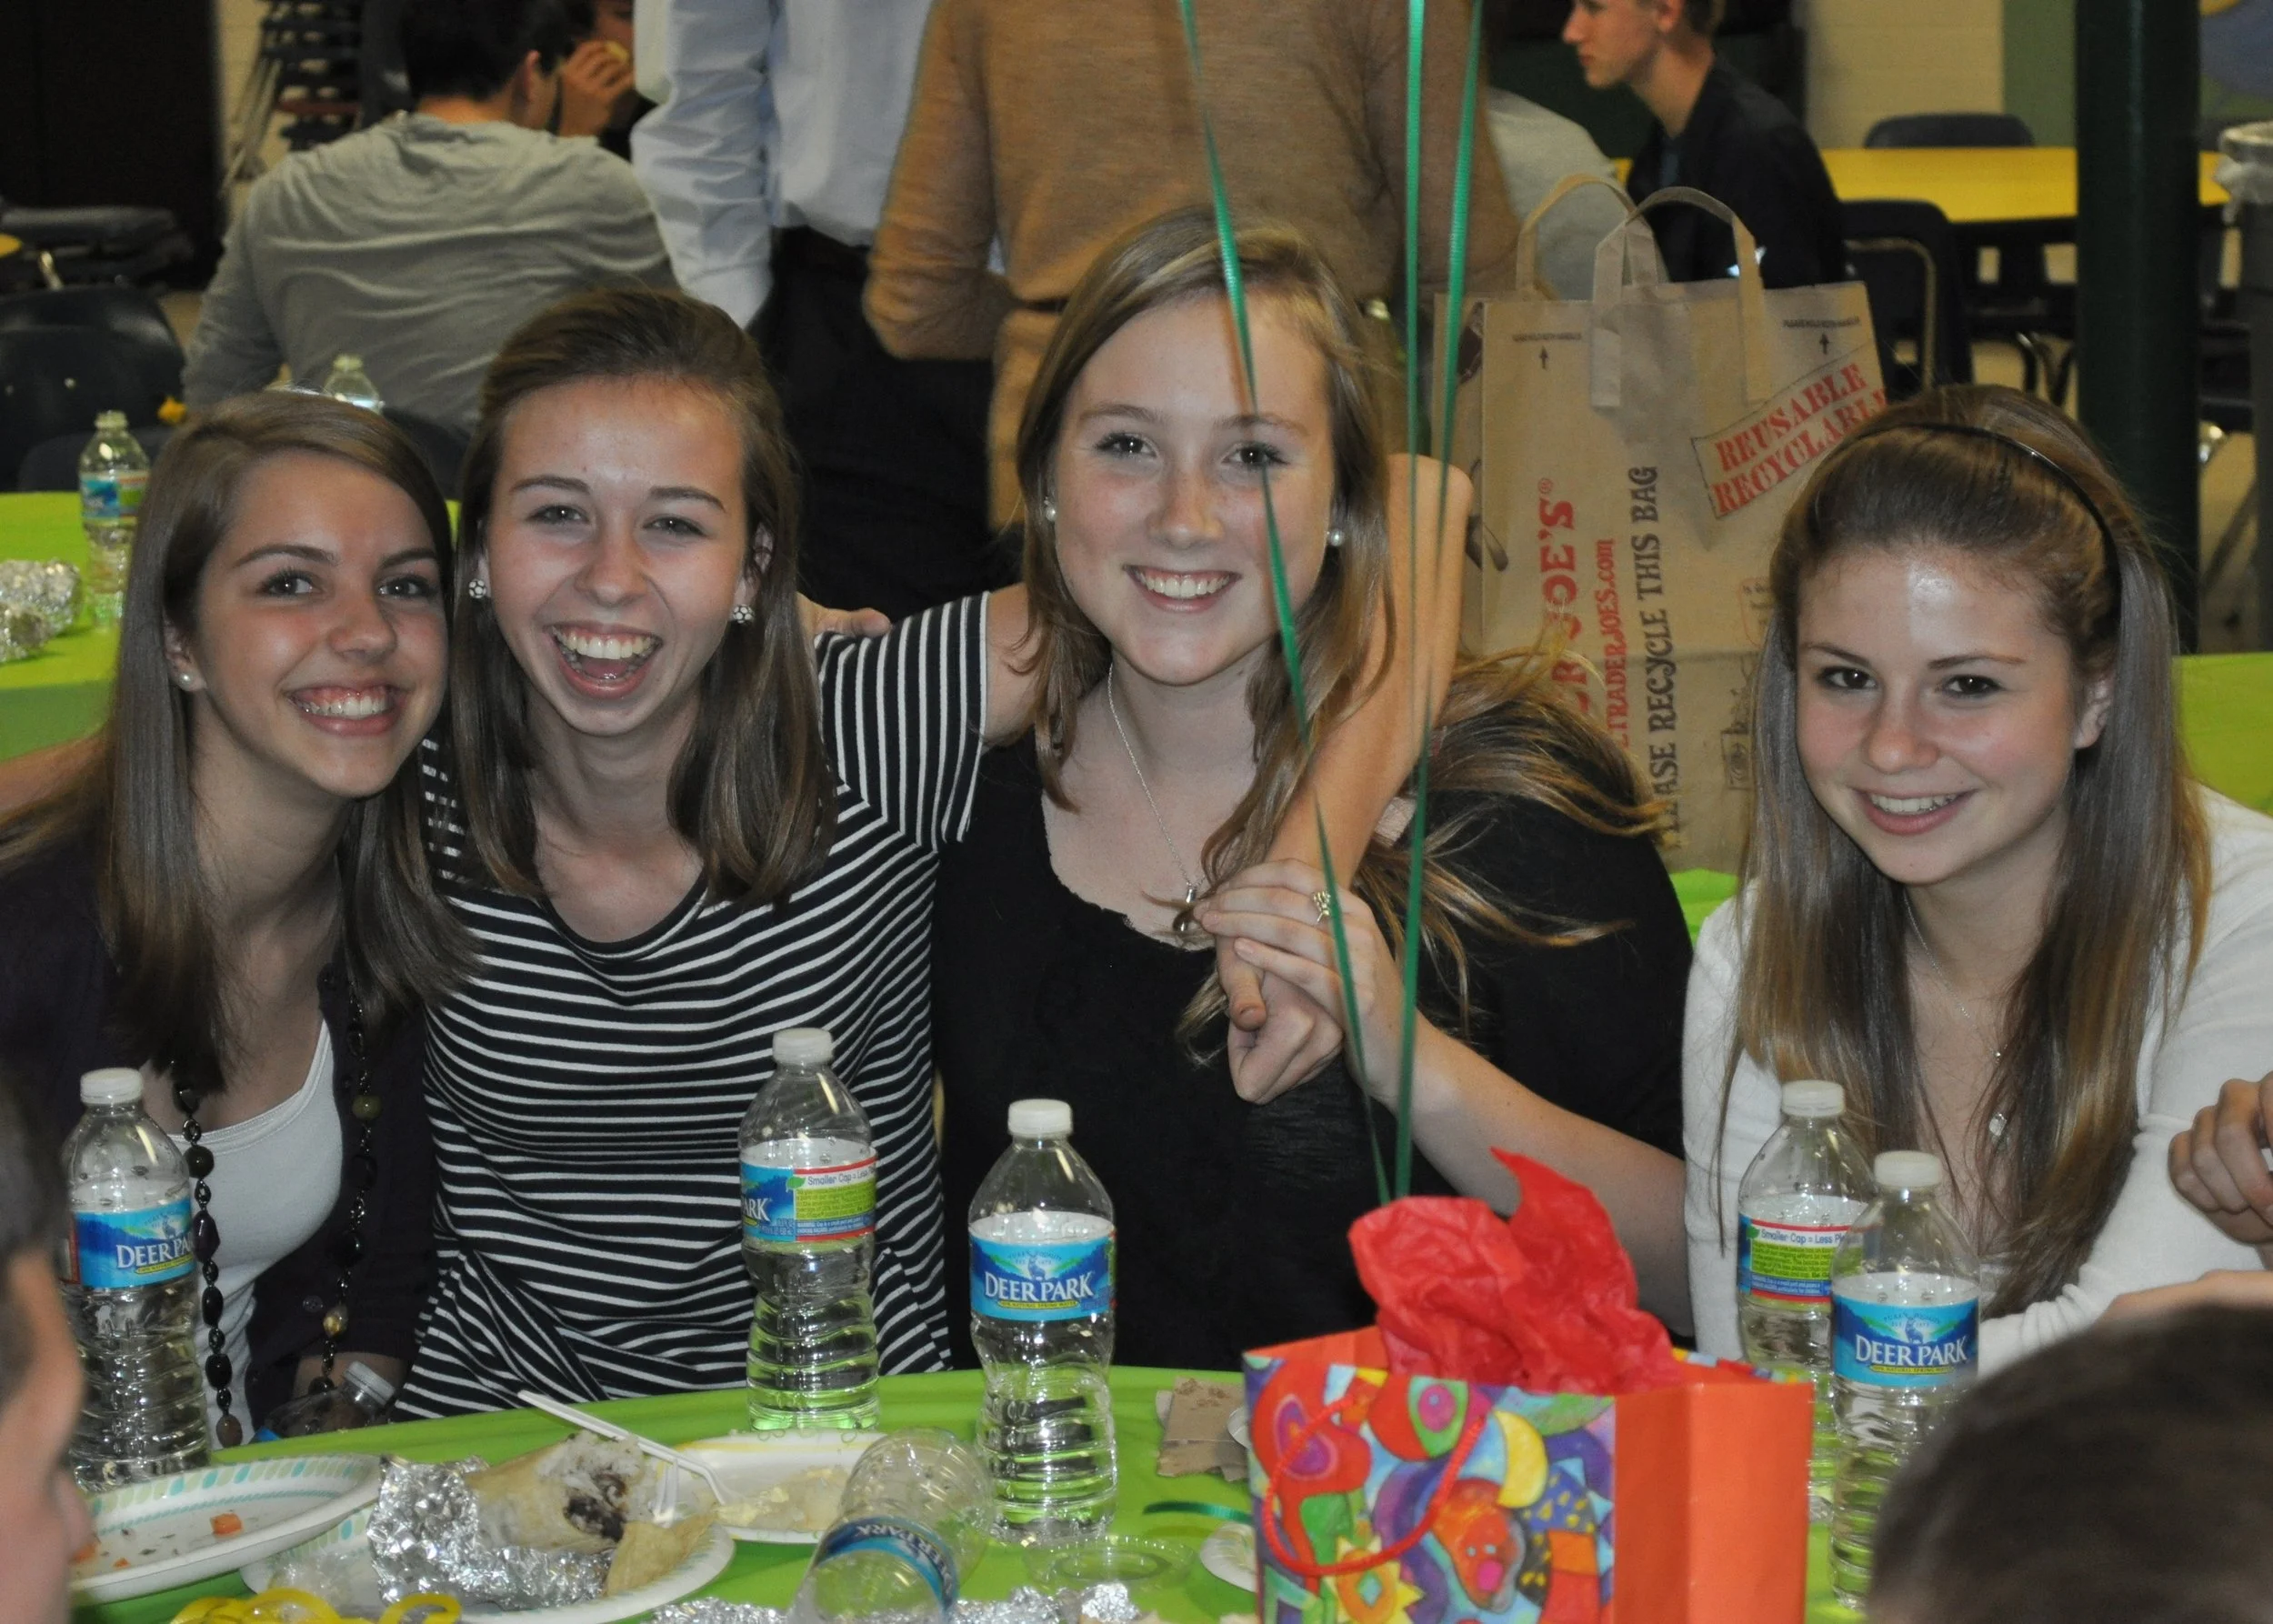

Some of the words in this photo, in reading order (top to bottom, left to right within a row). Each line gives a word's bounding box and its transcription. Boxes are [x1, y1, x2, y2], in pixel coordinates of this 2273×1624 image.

[1714, 363, 1867, 472] REUSABLE
[1627, 466, 1658, 524] BAG
[1632, 533, 1663, 601] THIS
[1639, 608, 1677, 734] RECYCLE
[807, 1175, 837, 1186] Smaller
[838, 1173, 851, 1184] Cap
[742, 1198, 770, 1221] ARK
[1761, 1228, 1788, 1241] Smaller
[1790, 1233, 1807, 1244] Cap
[1815, 1234, 1833, 1244] Less
[115, 1243, 173, 1269] DEER
[985, 1271, 1039, 1302] DEER
[1041, 1271, 1094, 1301] PARK
[1856, 1334, 1916, 1366] DEER
[1917, 1335, 1968, 1366] PARK
